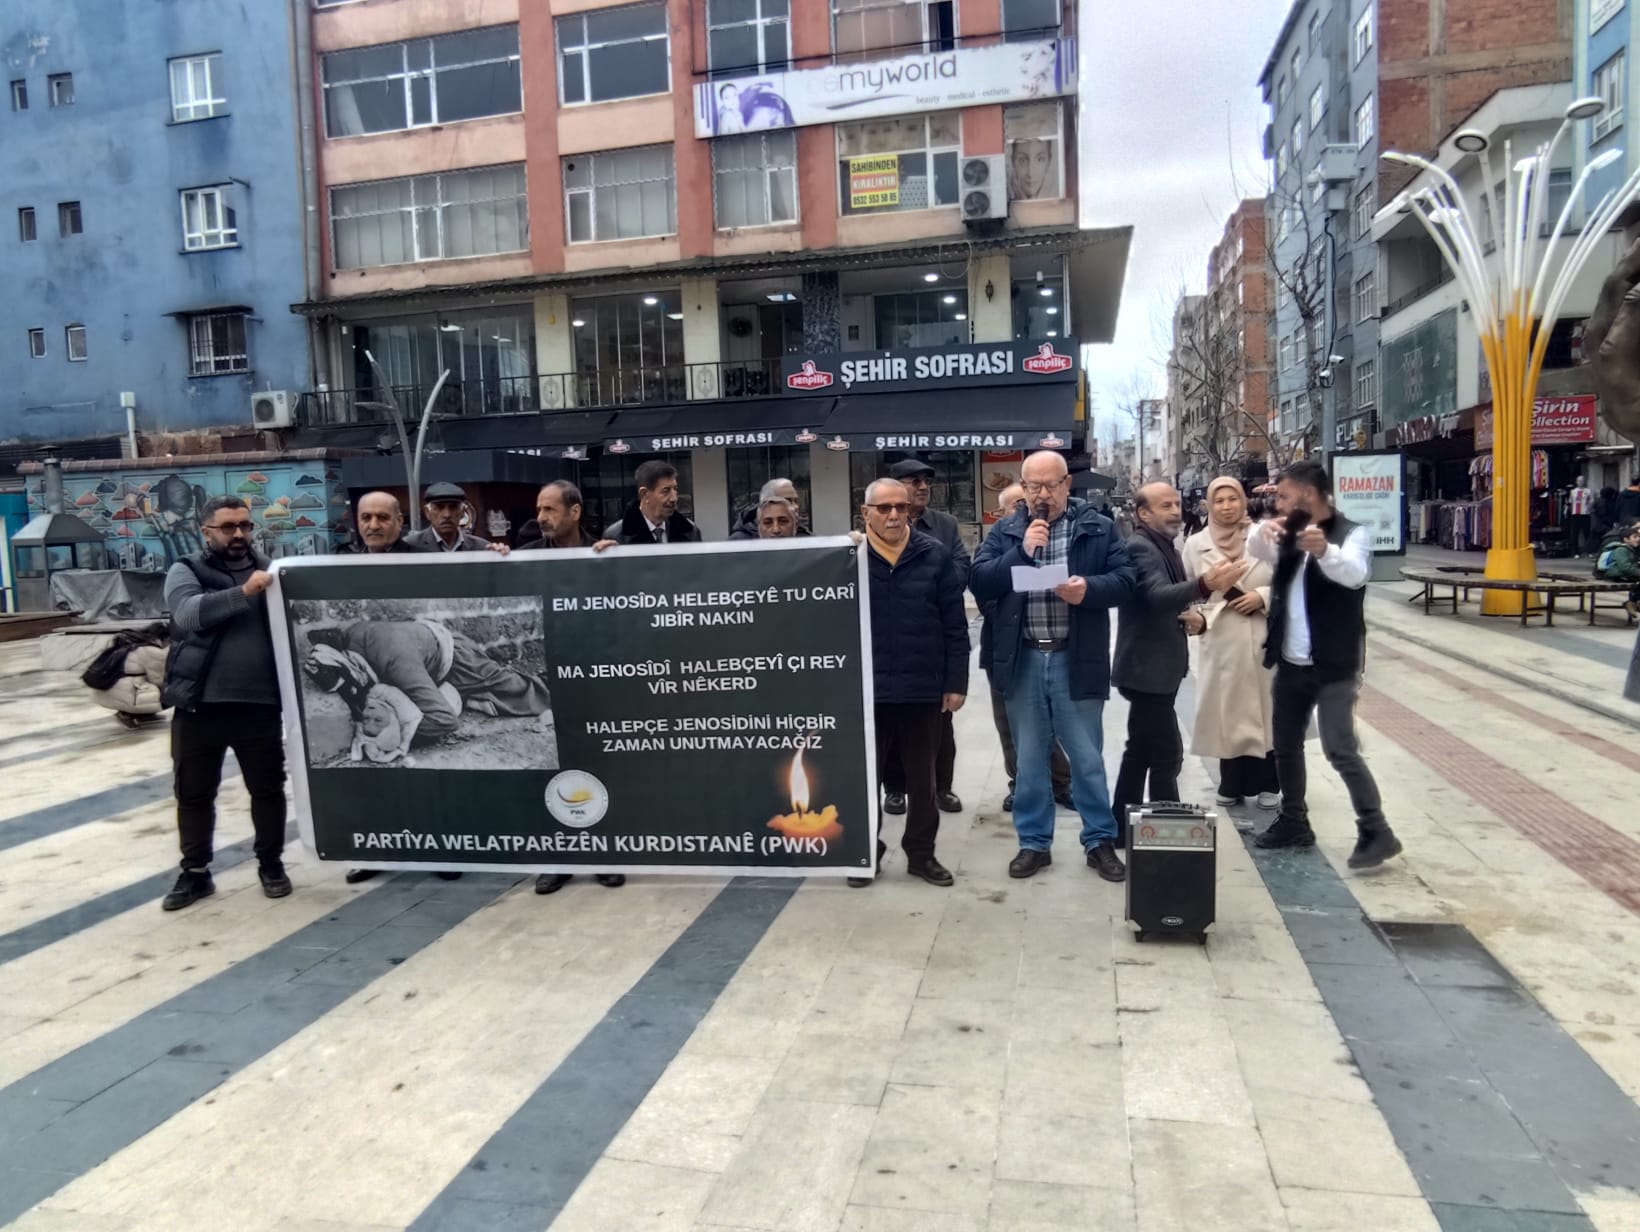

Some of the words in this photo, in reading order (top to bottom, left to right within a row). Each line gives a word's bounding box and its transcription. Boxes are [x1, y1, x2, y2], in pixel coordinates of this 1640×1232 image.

[840, 352, 907, 389] ŞEHİR
[914, 350, 1014, 379] SOFRASI
[1530, 415, 1590, 427] ollection
[652, 435, 700, 450] ŞEHİR
[704, 432, 773, 446] SOFRASI
[875, 434, 930, 449] ŞEHİR
[935, 434, 1014, 447] SOFRASI
[1339, 475, 1395, 492] RAMAZAN
[552, 597, 578, 612] EM
[581, 592, 670, 610] JENOSÎDA
[673, 586, 779, 607] HELEBÇEYÊ
[783, 587, 807, 601] TU
[811, 582, 855, 600] CARÎ
[650, 610, 695, 628] JIBÎR
[699, 610, 755, 625] NAKIN
[557, 665, 584, 679] MA
[588, 659, 671, 678] JENOSÎDÎ
[679, 652, 784, 675] HALEBÇEYÎ
[786, 655, 806, 672] ÇI
[809, 654, 847, 669] REY
[647, 679, 678, 695] VÎR
[682, 675, 758, 693] NÊKERD
[585, 718, 669, 735] HALEPÇE
[672, 713, 772, 732] JENOSİDİNİ
[775, 712, 837, 733] HİÇBİR
[602, 737, 665, 752] ZAMAN
[669, 731, 823, 750] UNUTMAYACAĞIZ
[352, 829, 439, 850] PARTÎYA
[441, 831, 608, 852] WELATPARÊZÊN
[614, 832, 755, 853] KURDISTANÊ
[760, 836, 828, 856] (PWK)
